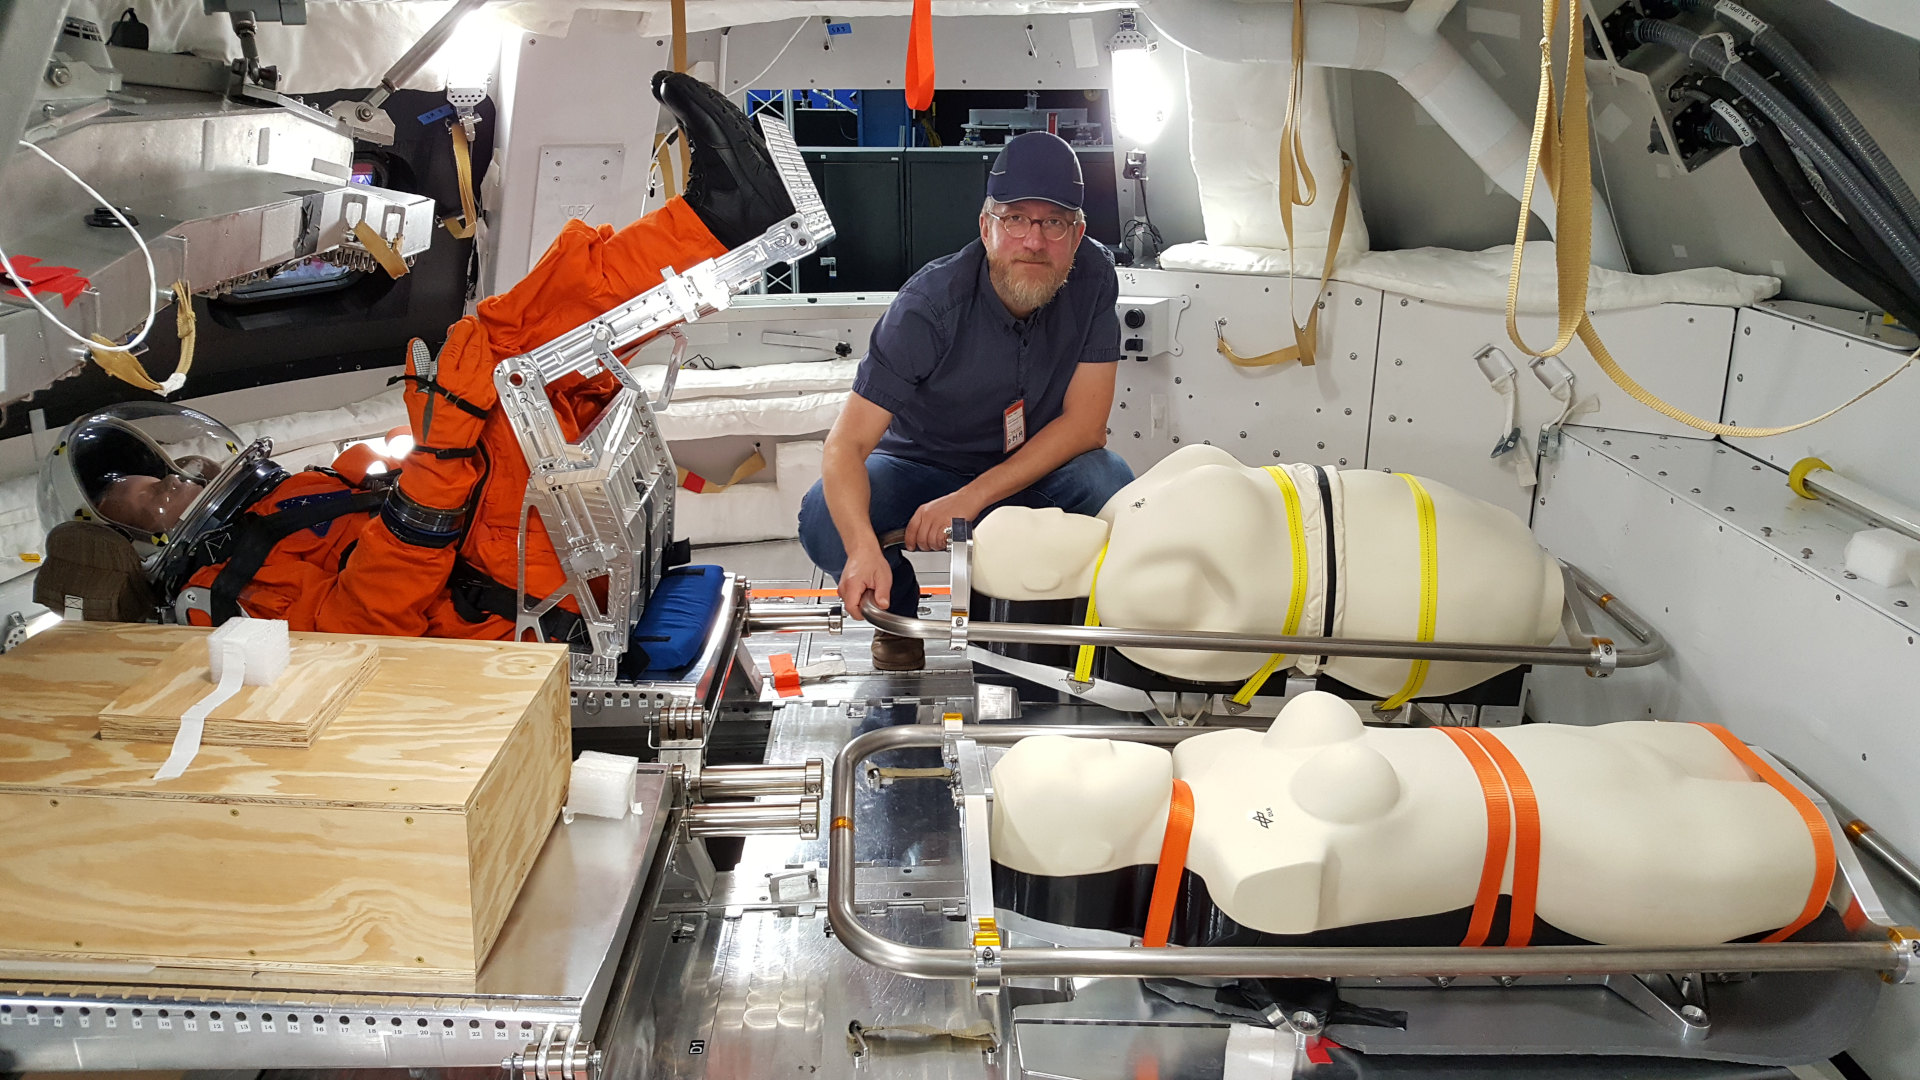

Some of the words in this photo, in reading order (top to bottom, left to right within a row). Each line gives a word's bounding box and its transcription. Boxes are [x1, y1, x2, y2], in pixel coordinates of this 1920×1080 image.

[1723, 2, 1747, 17] SUPPLY
[1721, 106, 1740, 124] SUPPLY
[1741, 127, 1750, 137] CW
[690, 1042, 704, 1054] D1
